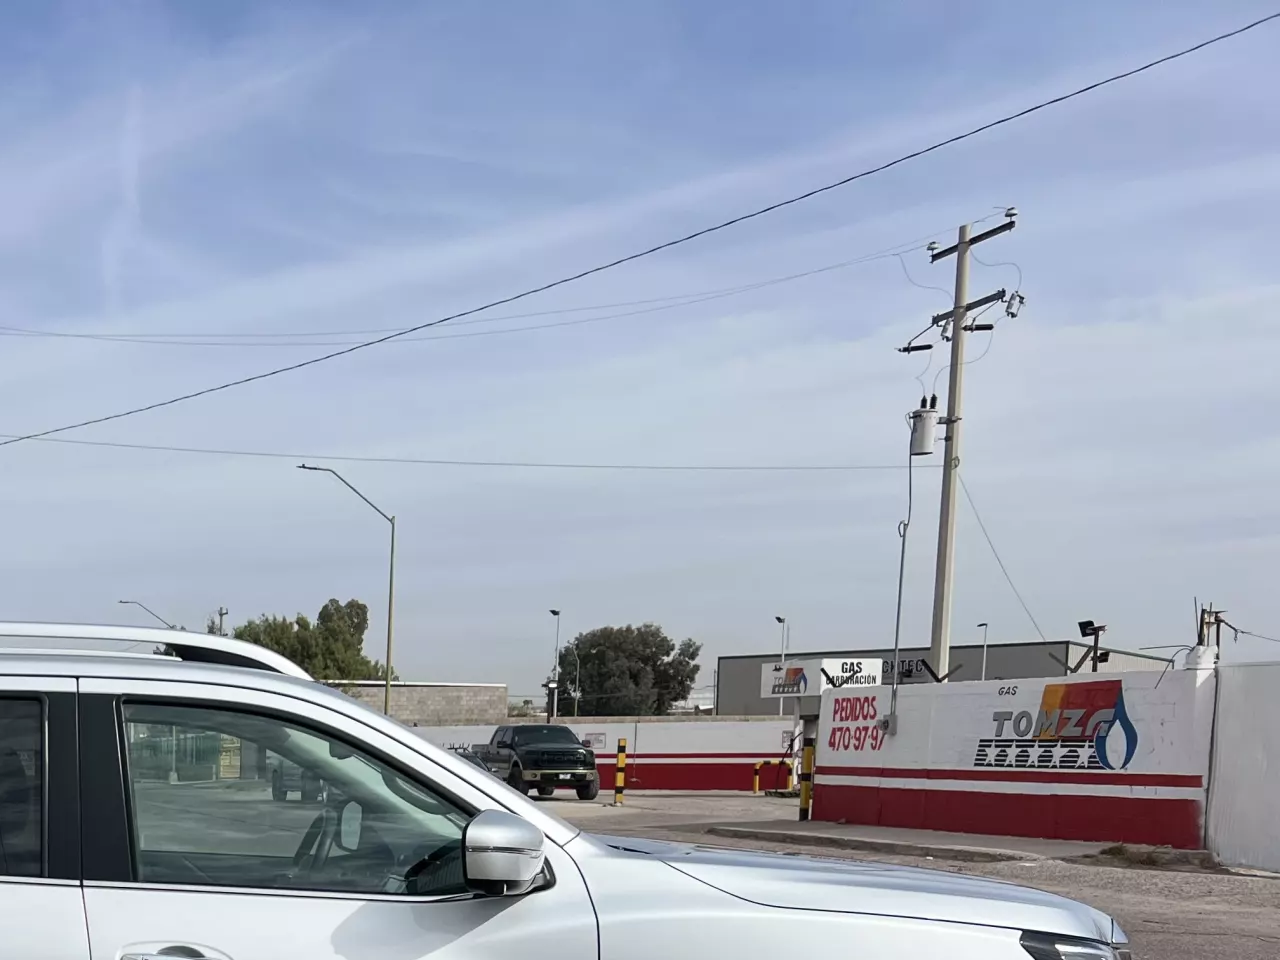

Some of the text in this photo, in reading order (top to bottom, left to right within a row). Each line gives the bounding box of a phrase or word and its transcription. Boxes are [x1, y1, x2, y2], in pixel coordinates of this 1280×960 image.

[841, 661, 862, 673] GAS
[998, 686, 1018, 696] GAS
[832, 696, 877, 722] PEDIDOS
[993, 708, 1115, 737] TOMZA
